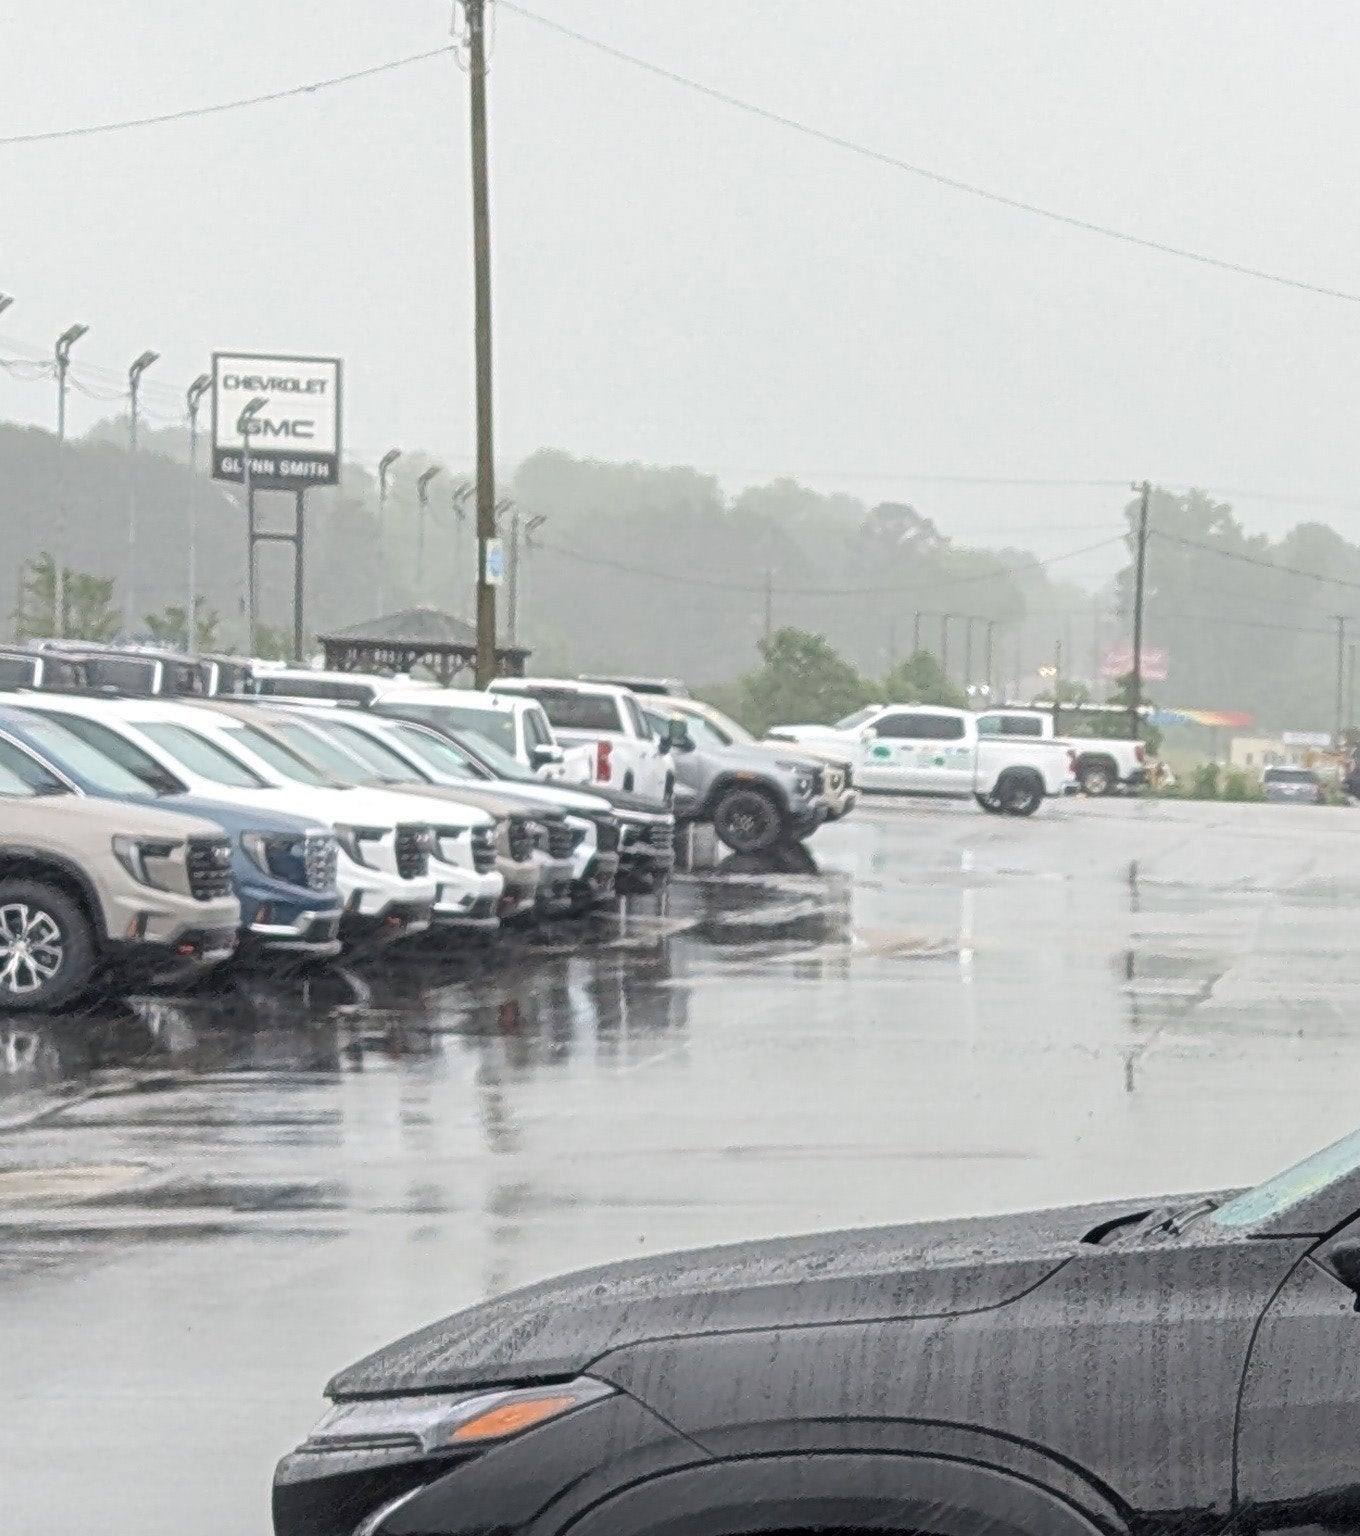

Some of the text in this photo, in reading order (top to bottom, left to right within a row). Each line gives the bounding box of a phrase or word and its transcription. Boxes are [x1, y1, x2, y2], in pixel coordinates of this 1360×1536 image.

[222, 374, 329, 394] CHEVROLET
[237, 417, 315, 439] GMC
[279, 460, 330, 478] SMITH
